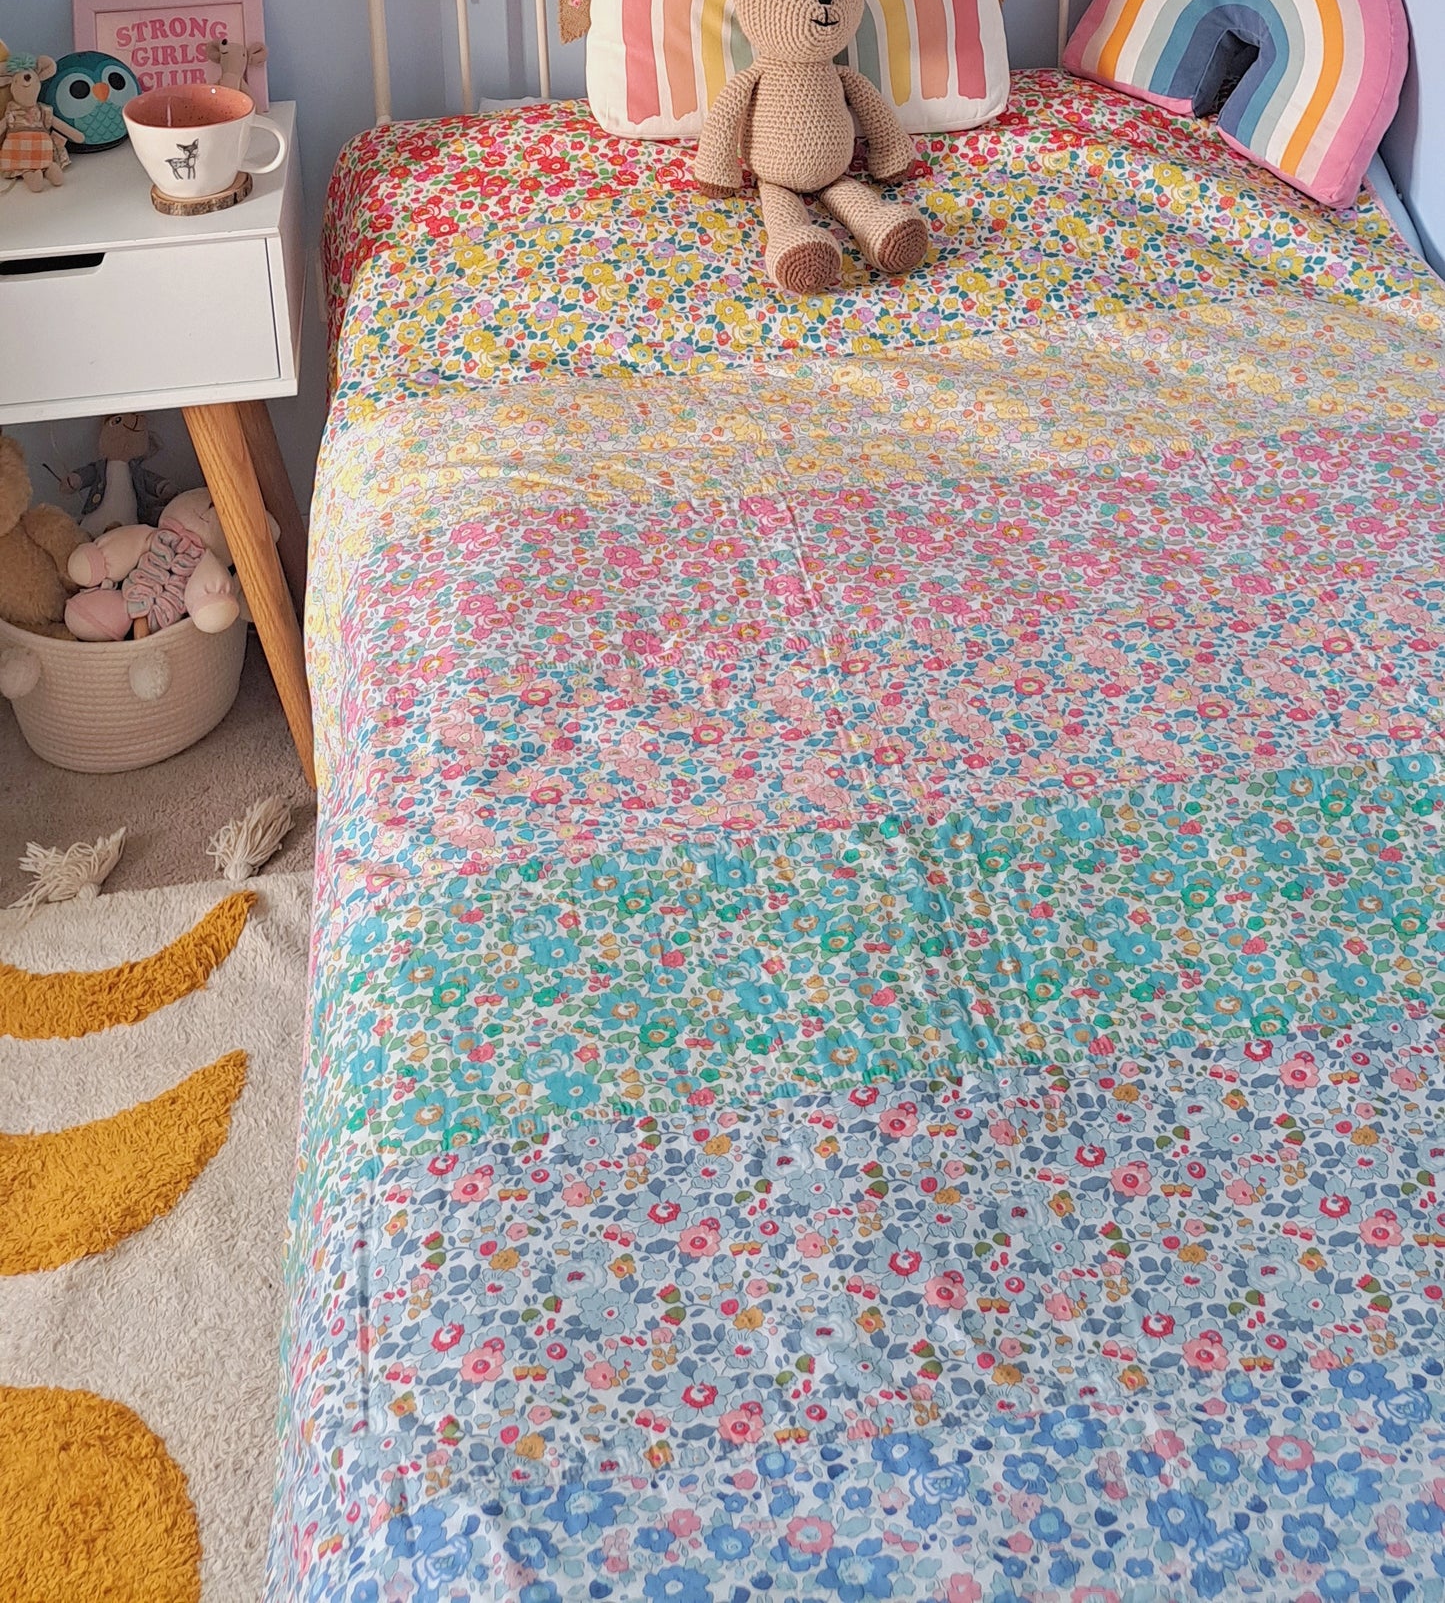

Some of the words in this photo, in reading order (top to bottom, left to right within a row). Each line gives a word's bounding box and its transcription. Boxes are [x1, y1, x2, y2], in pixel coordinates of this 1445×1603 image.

[116, 16, 228, 48] STRONG
[131, 42, 209, 68] GIRLS
[138, 68, 207, 92] CLUB
